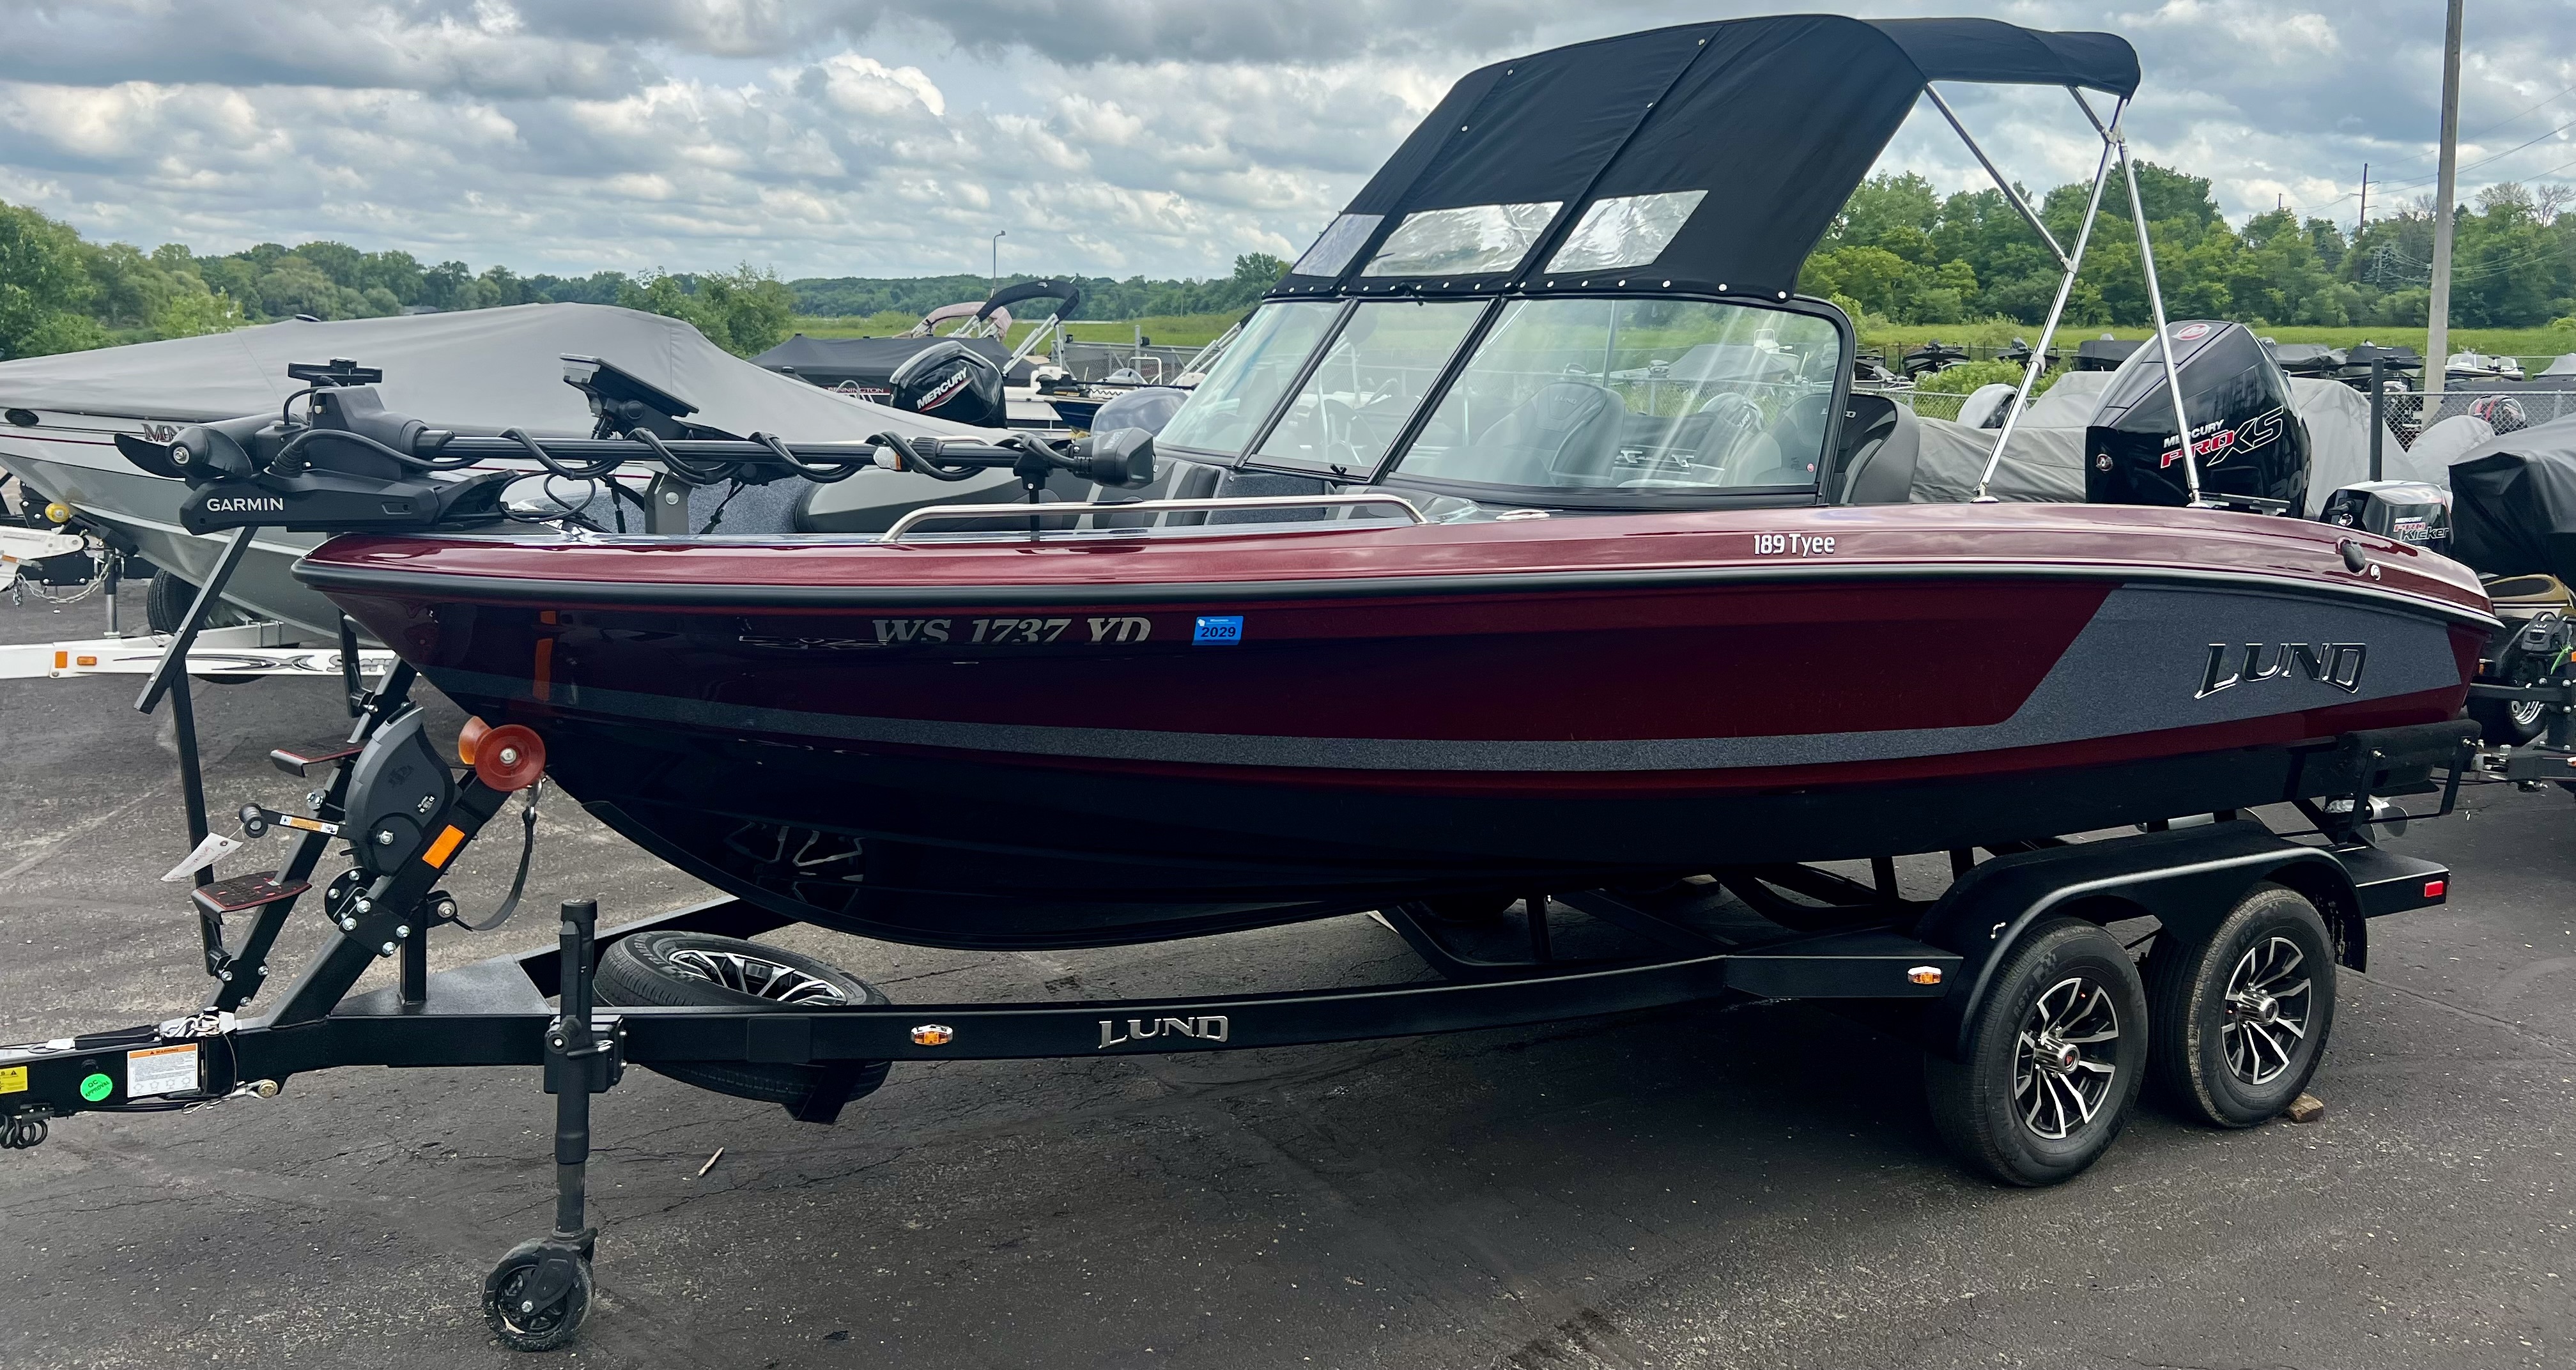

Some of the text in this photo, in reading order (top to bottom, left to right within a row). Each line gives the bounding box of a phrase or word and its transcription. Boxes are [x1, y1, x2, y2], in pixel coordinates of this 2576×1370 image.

[916, 366, 968, 410] MERCURY
[206, 498, 284, 511] GARMIN
[1754, 533, 1835, 558] 189 Tyee
[872, 617, 1152, 645] WS 1737 YD
[1201, 626, 1237, 638] 2029
[2194, 643, 2367, 700] LUND
[1097, 1015, 1228, 1049] LUND
